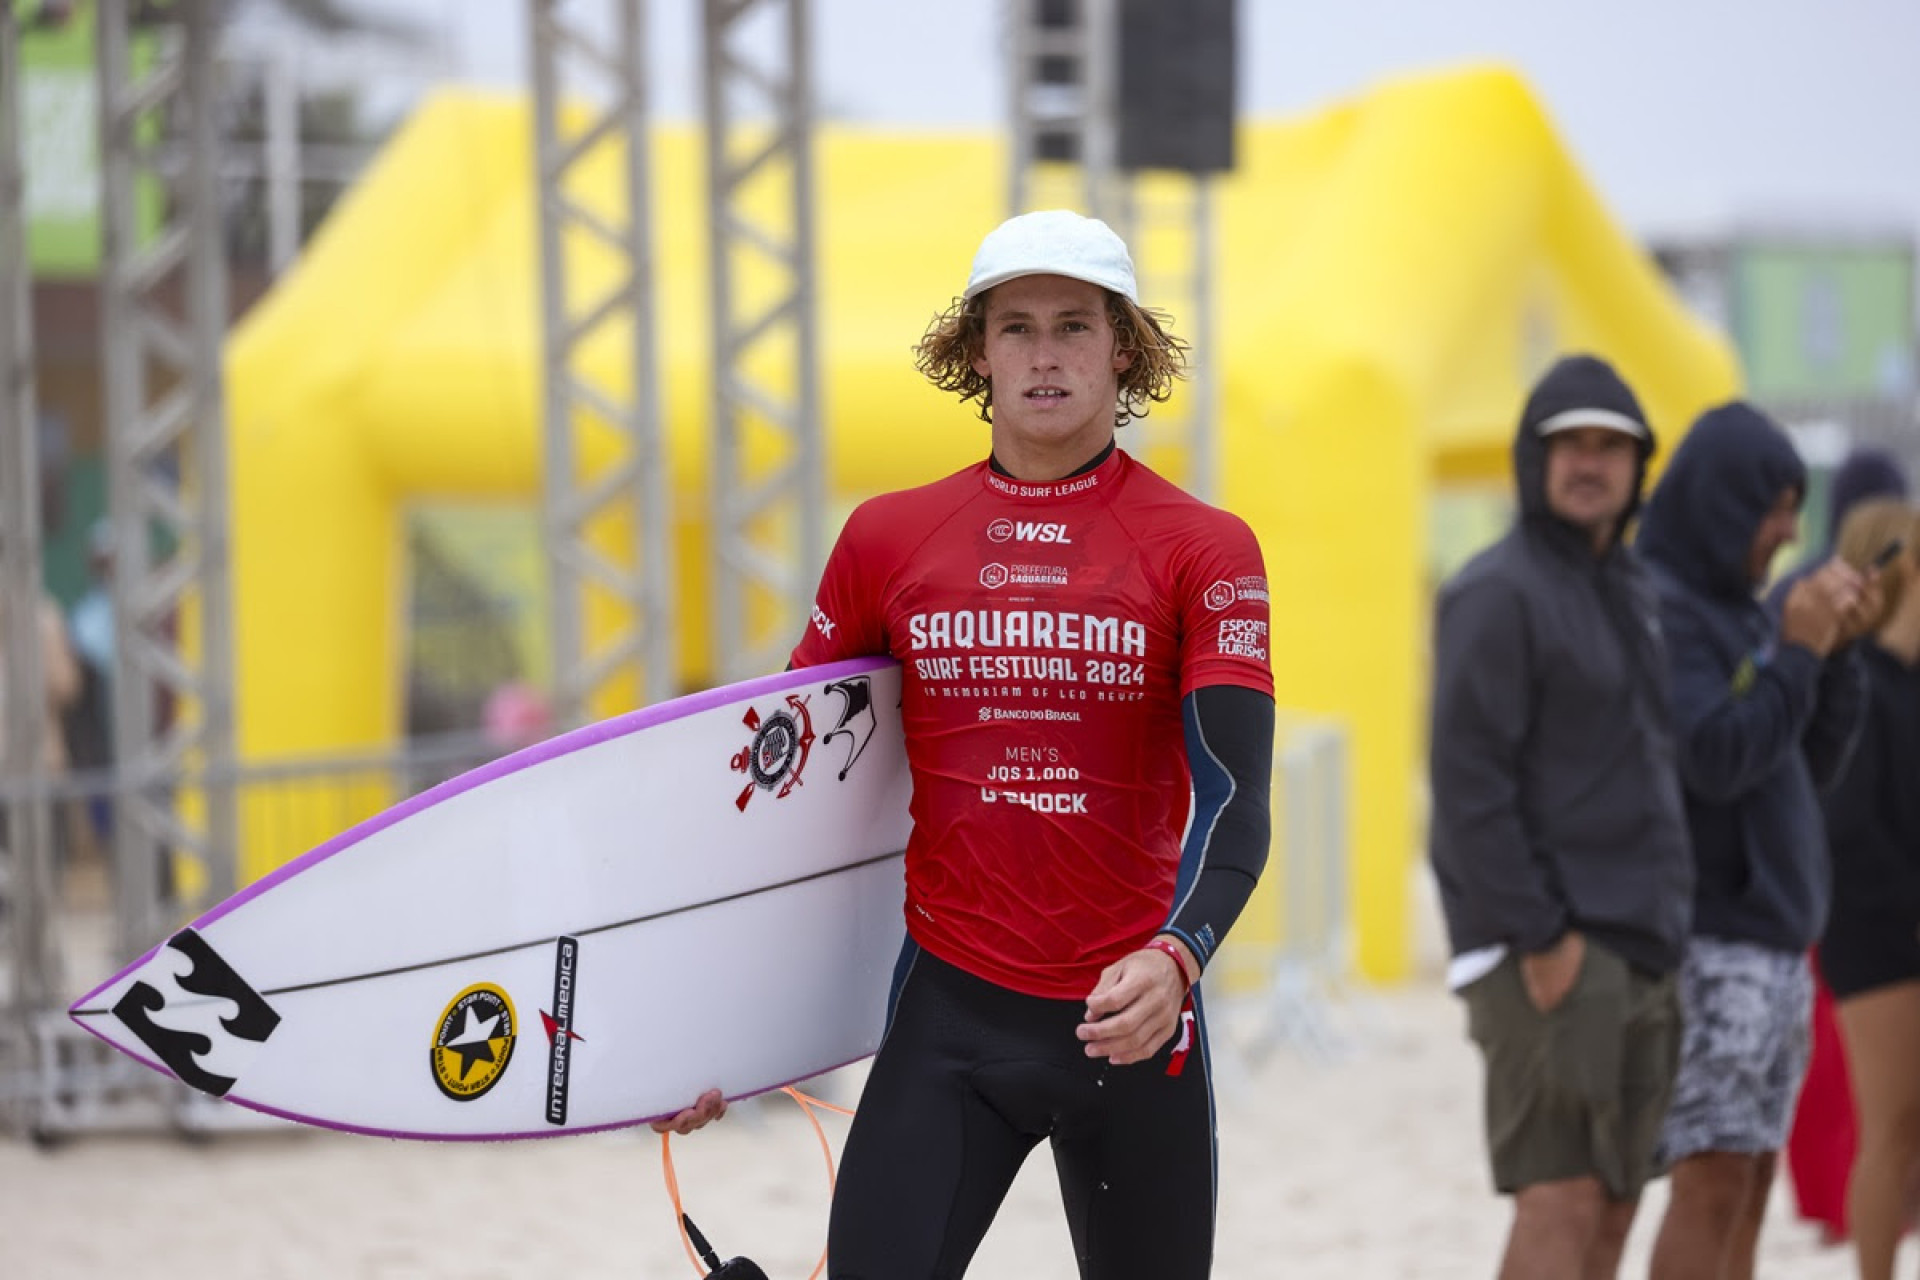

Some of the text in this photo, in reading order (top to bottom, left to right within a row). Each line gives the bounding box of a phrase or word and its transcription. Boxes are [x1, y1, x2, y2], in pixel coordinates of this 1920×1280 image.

[1020, 486, 1051, 497] SURF
[1055, 475, 1098, 497] LEAGUE
[1016, 521, 1071, 544] WSL
[1010, 574, 1068, 585] SAQUAREMA
[909, 610, 1146, 657] SAQUAREMA
[1220, 619, 1267, 635] ESPORTE
[1218, 631, 1257, 645] LAZER
[1218, 642, 1266, 661] TURISMO
[915, 655, 1145, 685] SURF FESTIVAL 2024
[944, 686, 1021, 697] MEMORIAM
[1032, 687, 1049, 697] OF
[1059, 689, 1086, 700] LEO
[994, 708, 1028, 719] BANCO
[1045, 709, 1081, 721] BRASIL
[1006, 747, 1058, 762] MEN'S
[987, 765, 1021, 782] JQS
